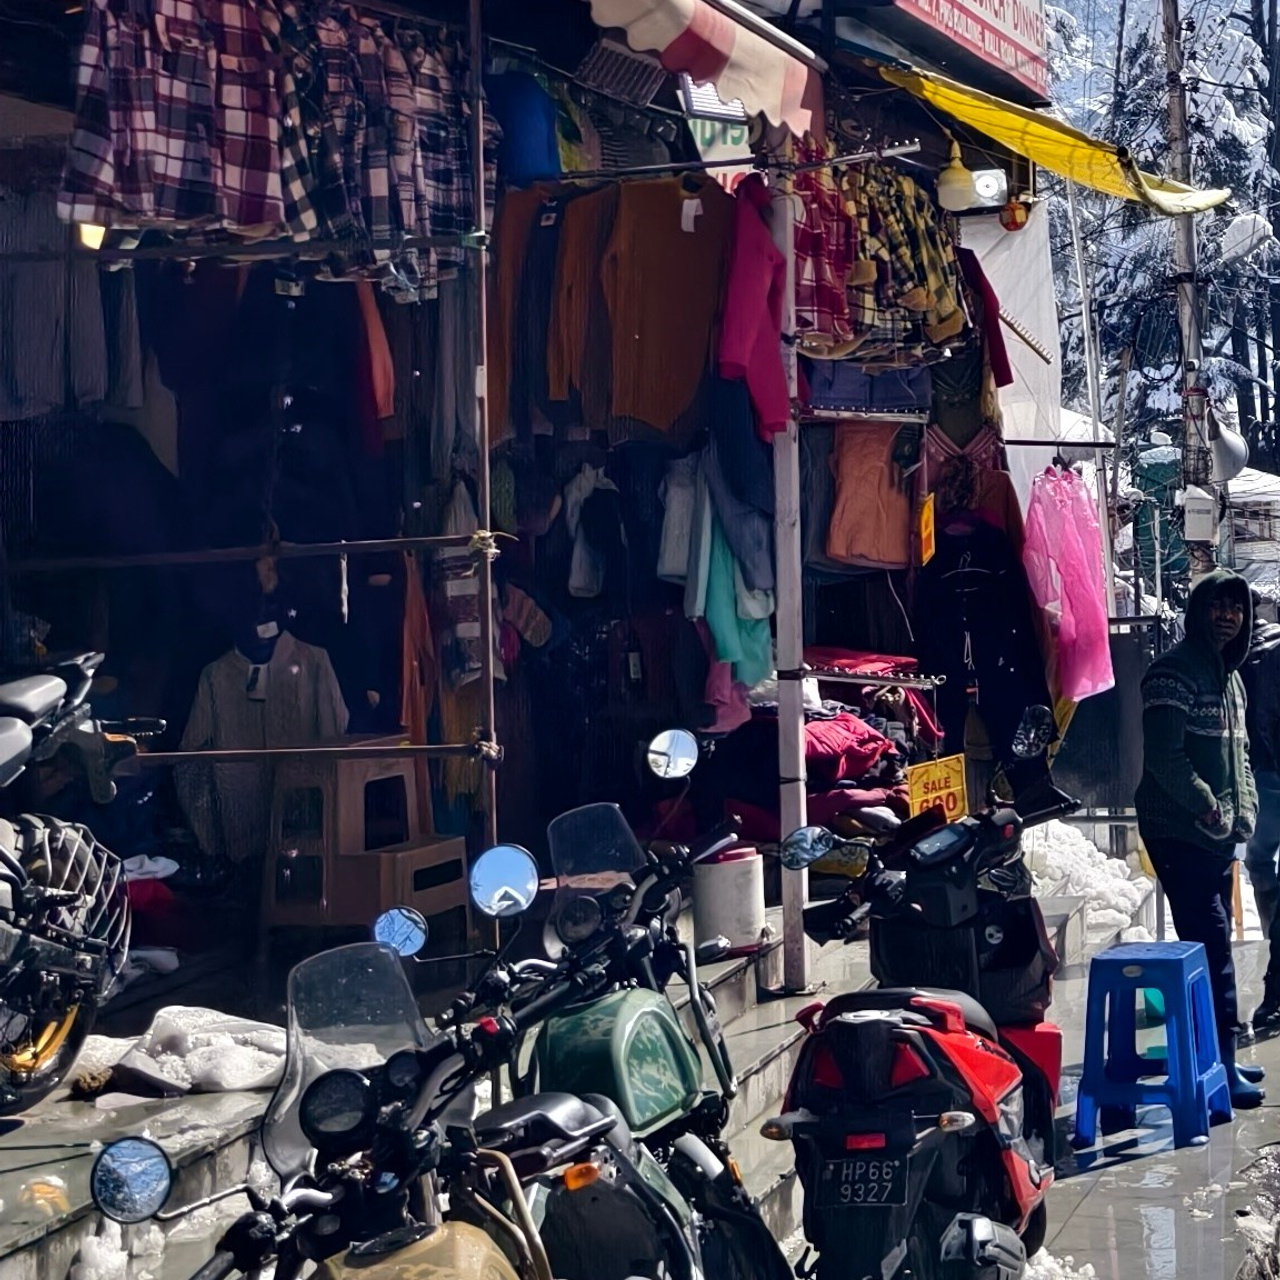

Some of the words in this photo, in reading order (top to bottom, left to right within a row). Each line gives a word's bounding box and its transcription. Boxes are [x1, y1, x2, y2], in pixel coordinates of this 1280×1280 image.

[923, 776, 951, 795] SALE
[841, 1161, 893, 1182] HP66
[840, 1182, 892, 1202] 9327
